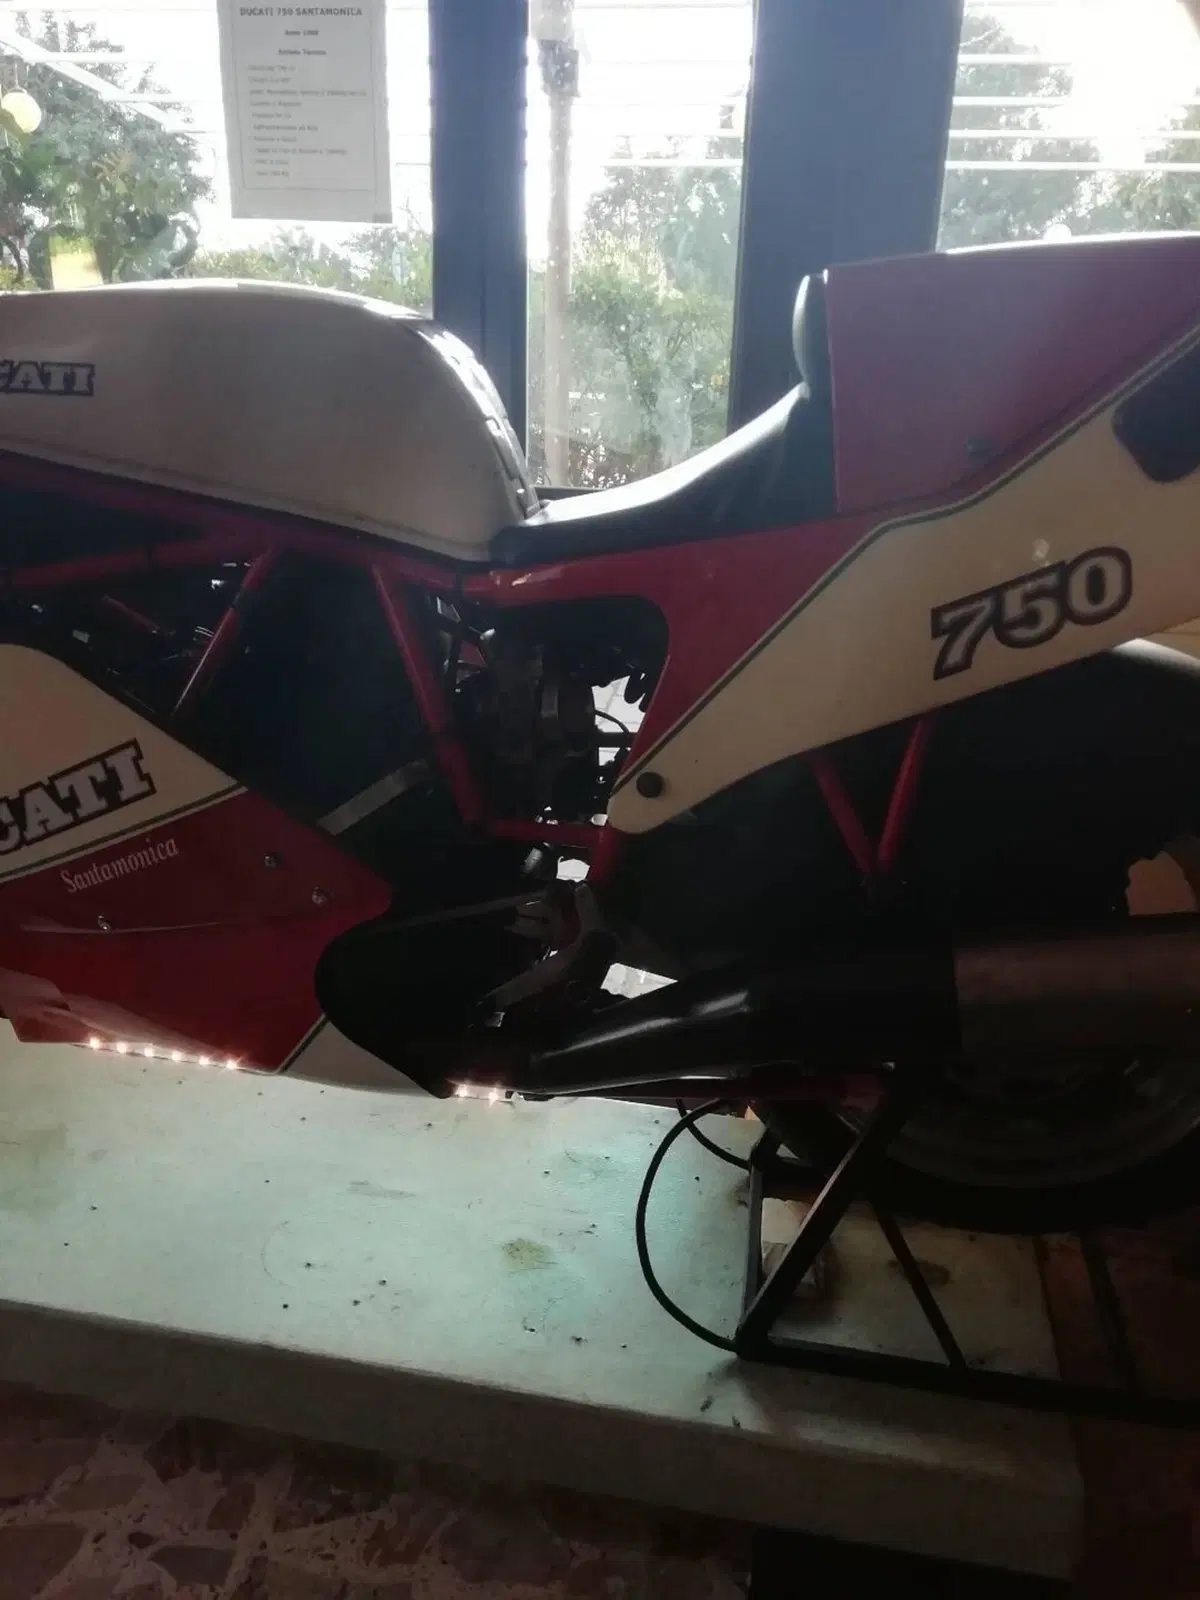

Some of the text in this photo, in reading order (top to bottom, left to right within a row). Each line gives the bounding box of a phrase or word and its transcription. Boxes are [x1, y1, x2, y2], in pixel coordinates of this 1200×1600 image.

[239, 7, 363, 17] DUCATI 750 SANTAMONICA
[931, 546, 1132, 681] 750
[60, 837, 180, 893] Santamonica
